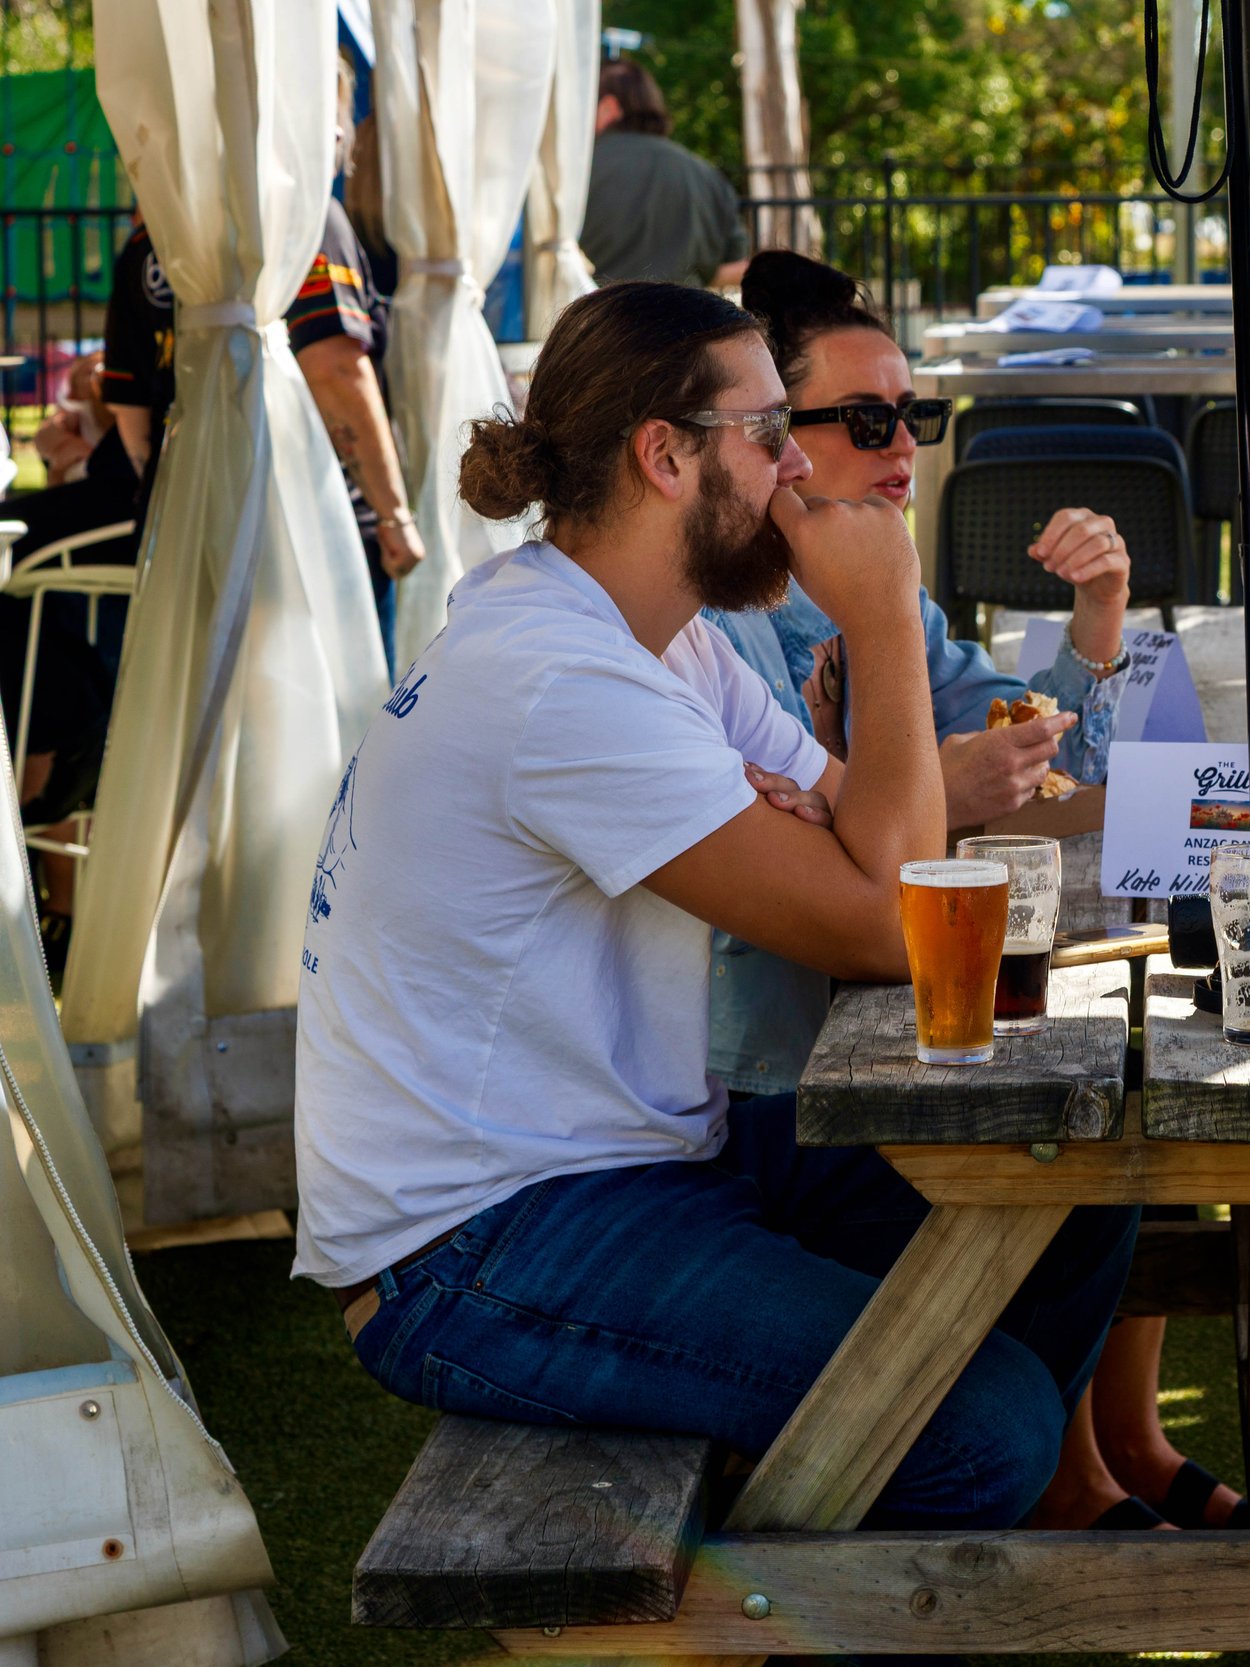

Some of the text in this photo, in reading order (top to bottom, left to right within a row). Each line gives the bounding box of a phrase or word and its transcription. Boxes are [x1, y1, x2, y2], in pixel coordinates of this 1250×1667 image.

[1194, 767, 1250, 796] Grill
[1185, 838, 1228, 849] ANZAC
[1188, 855, 1210, 867] RES
[1116, 868, 1161, 892] Kate
[302, 947, 319, 974] OLE
